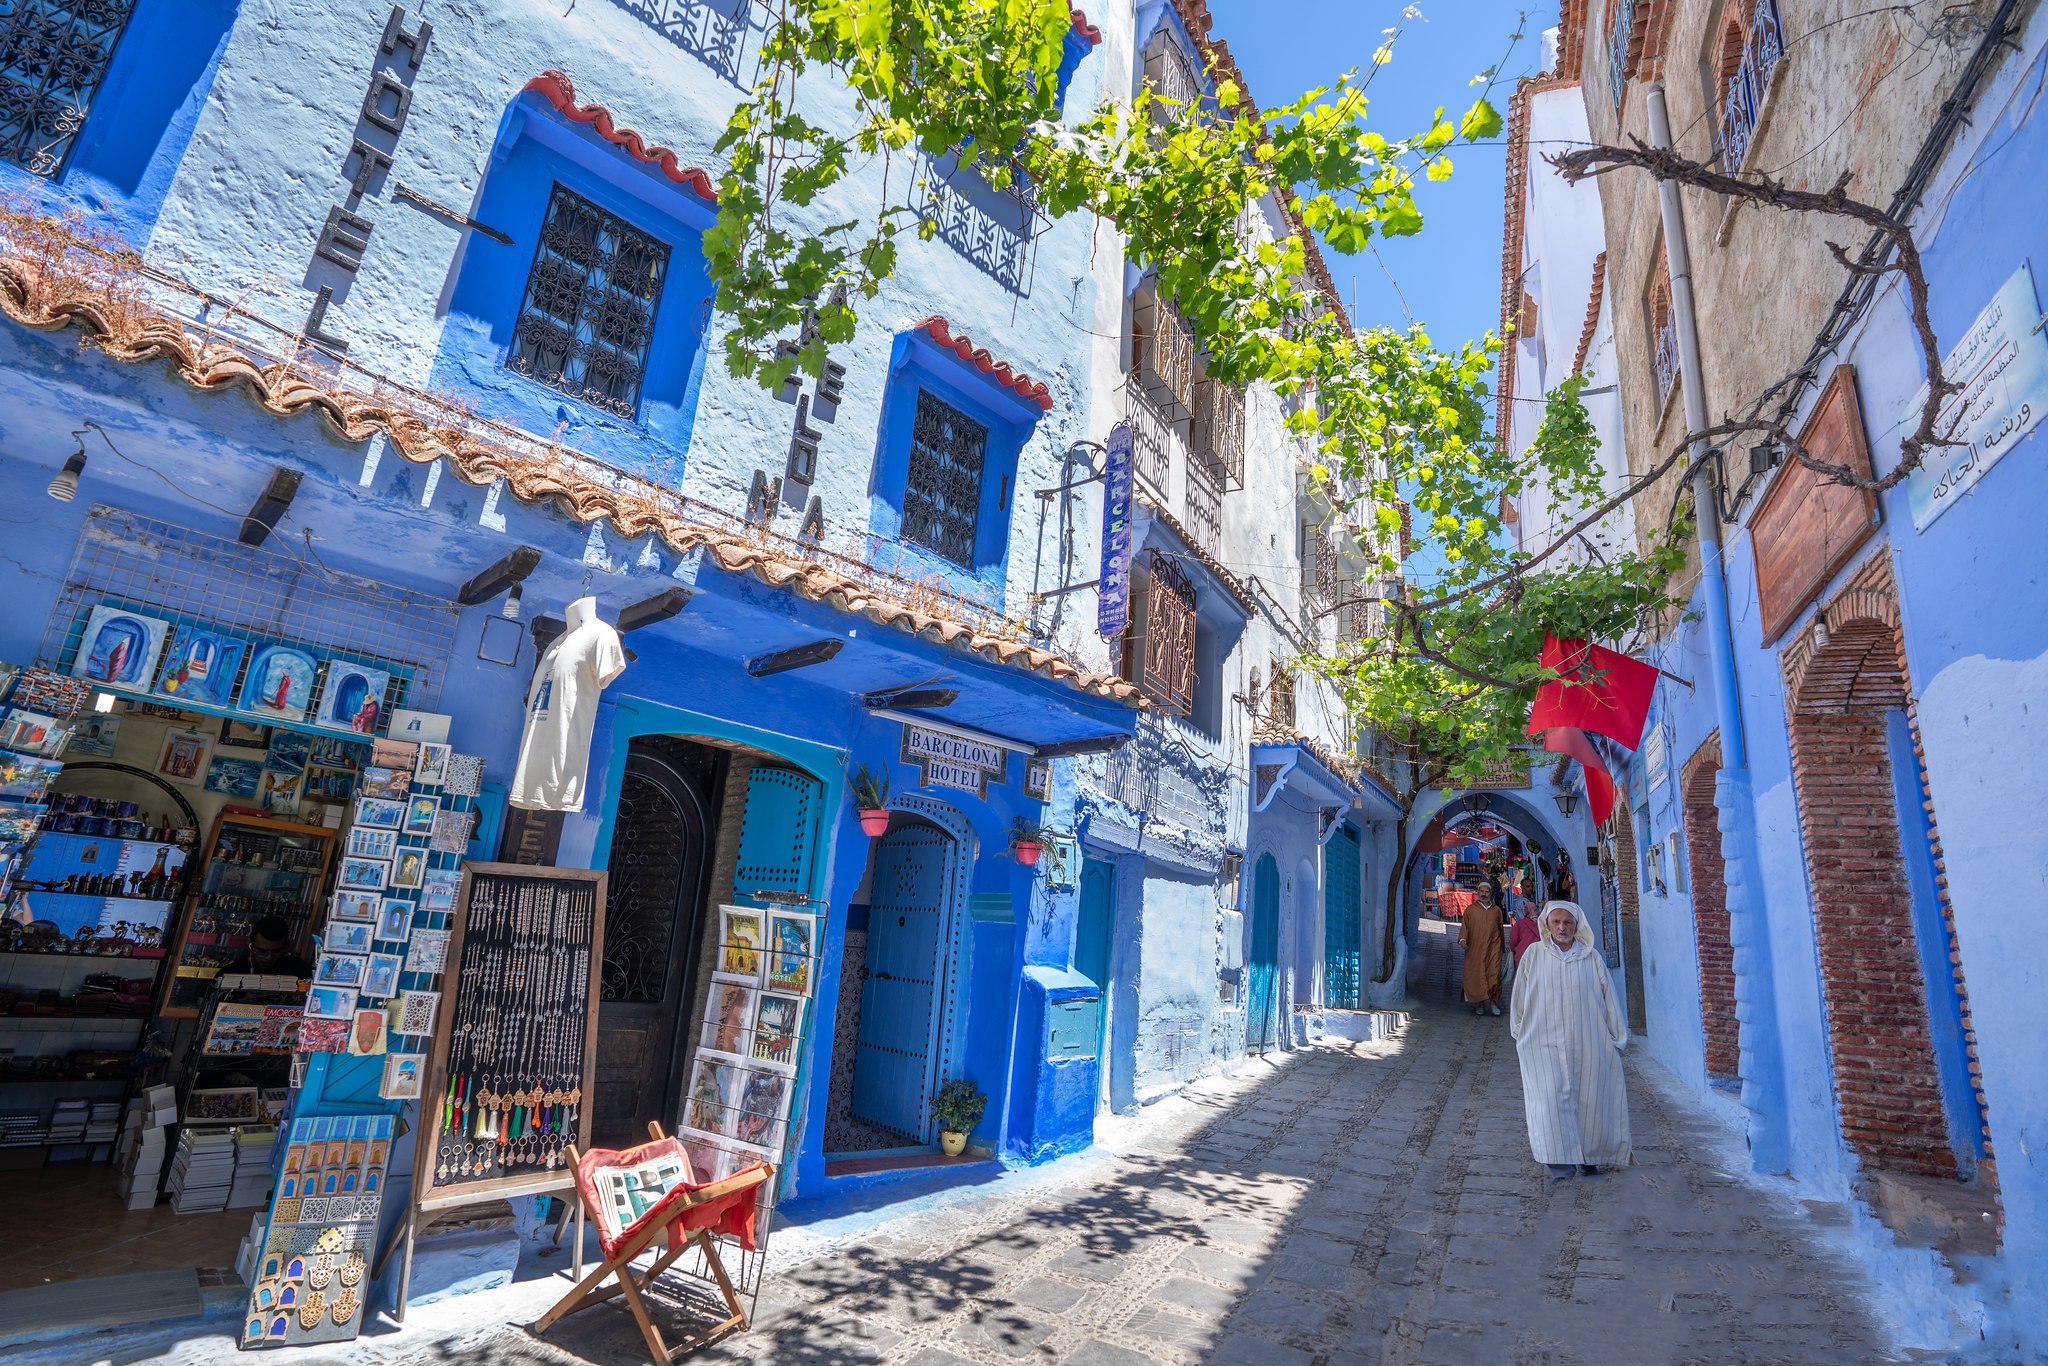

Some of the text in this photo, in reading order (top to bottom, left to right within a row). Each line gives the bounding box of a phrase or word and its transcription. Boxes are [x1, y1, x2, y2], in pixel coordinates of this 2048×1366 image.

[305, 4, 432, 353] HOTEL
[1987, 340, 2020, 382] المنظمة
[1971, 397, 1994, 422] بمدينة
[1933, 403, 2031, 499] ورشة الحياكة
[1106, 452, 1128, 605] BARCELONA
[911, 731, 1000, 767] BARCELONA
[930, 763, 979, 788] HOTEL
[1032, 771, 1047, 787] 12
